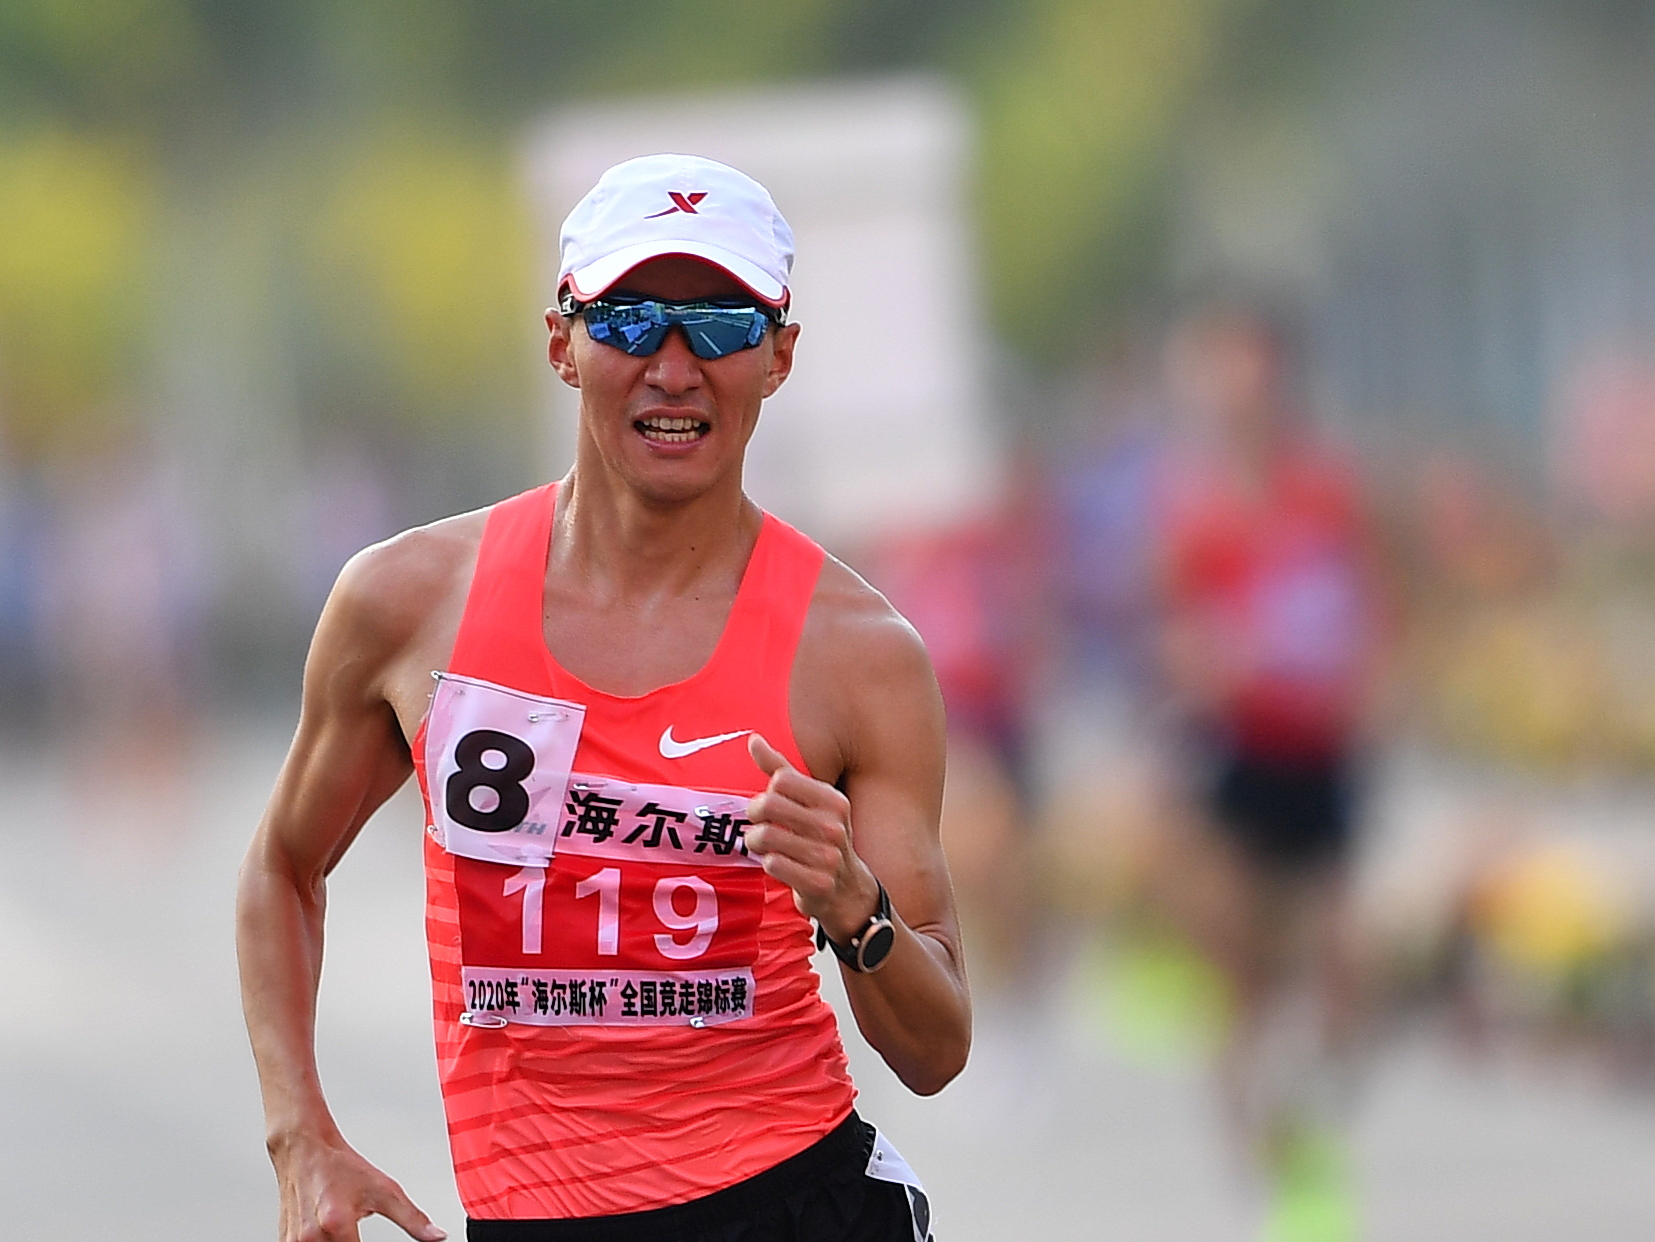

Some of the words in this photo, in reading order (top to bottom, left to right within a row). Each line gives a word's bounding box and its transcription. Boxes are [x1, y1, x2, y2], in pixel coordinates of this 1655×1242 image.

[445, 729, 535, 832] 8
[561, 789, 753, 856] 海尔斯
[503, 867, 720, 960] 119
